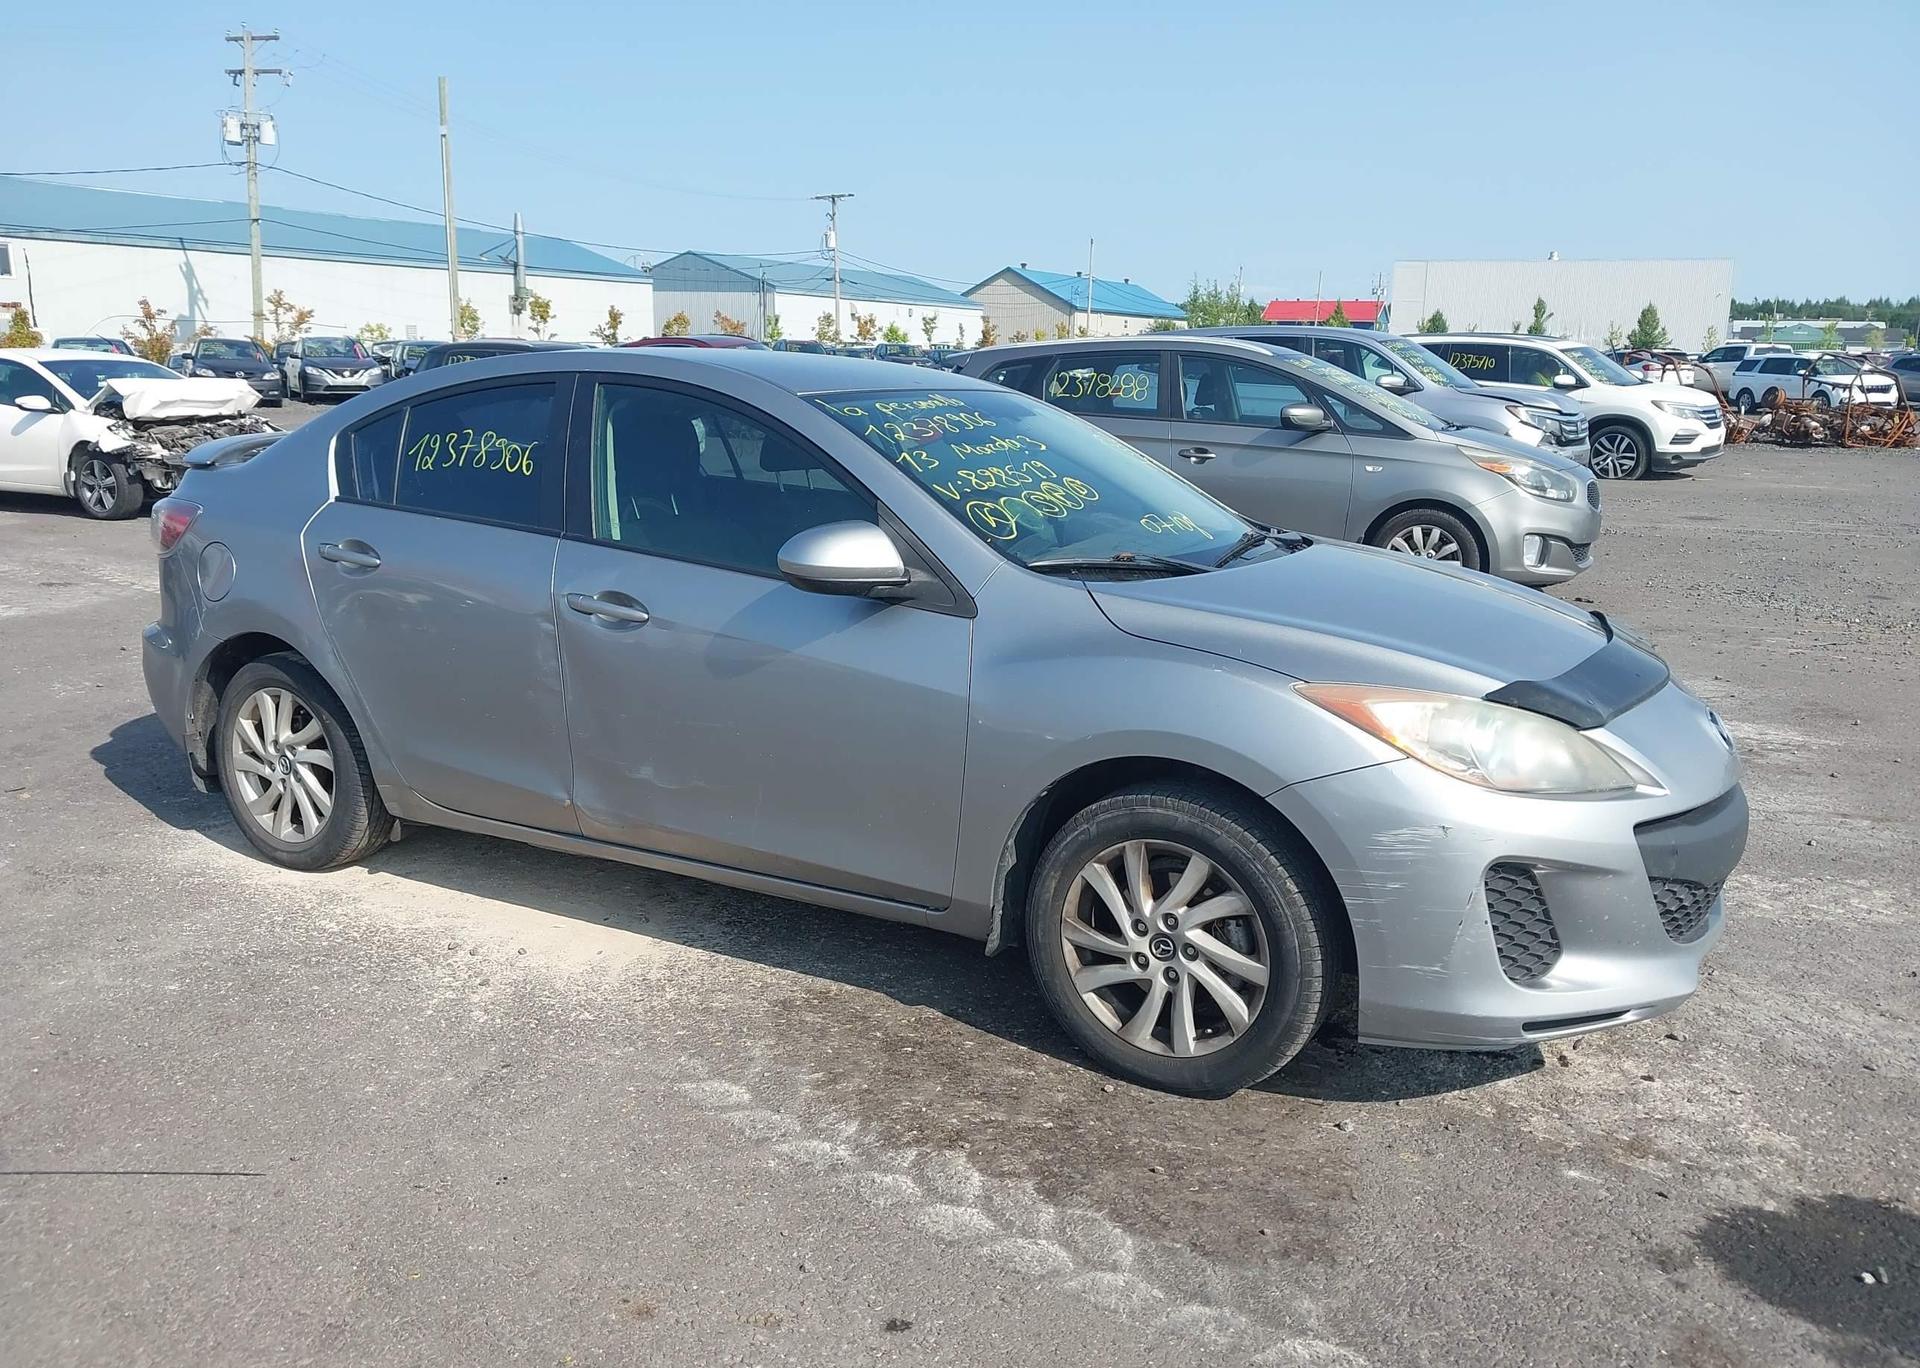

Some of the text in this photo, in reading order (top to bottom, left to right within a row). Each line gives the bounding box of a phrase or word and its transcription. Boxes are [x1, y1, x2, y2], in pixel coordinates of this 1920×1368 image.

[1450, 351, 1496, 370] 12375710
[1050, 372, 1150, 401] 12378288
[864, 411, 997, 444] 12378906
[408, 429, 538, 476] 12378906
[896, 450, 940, 472] 13
